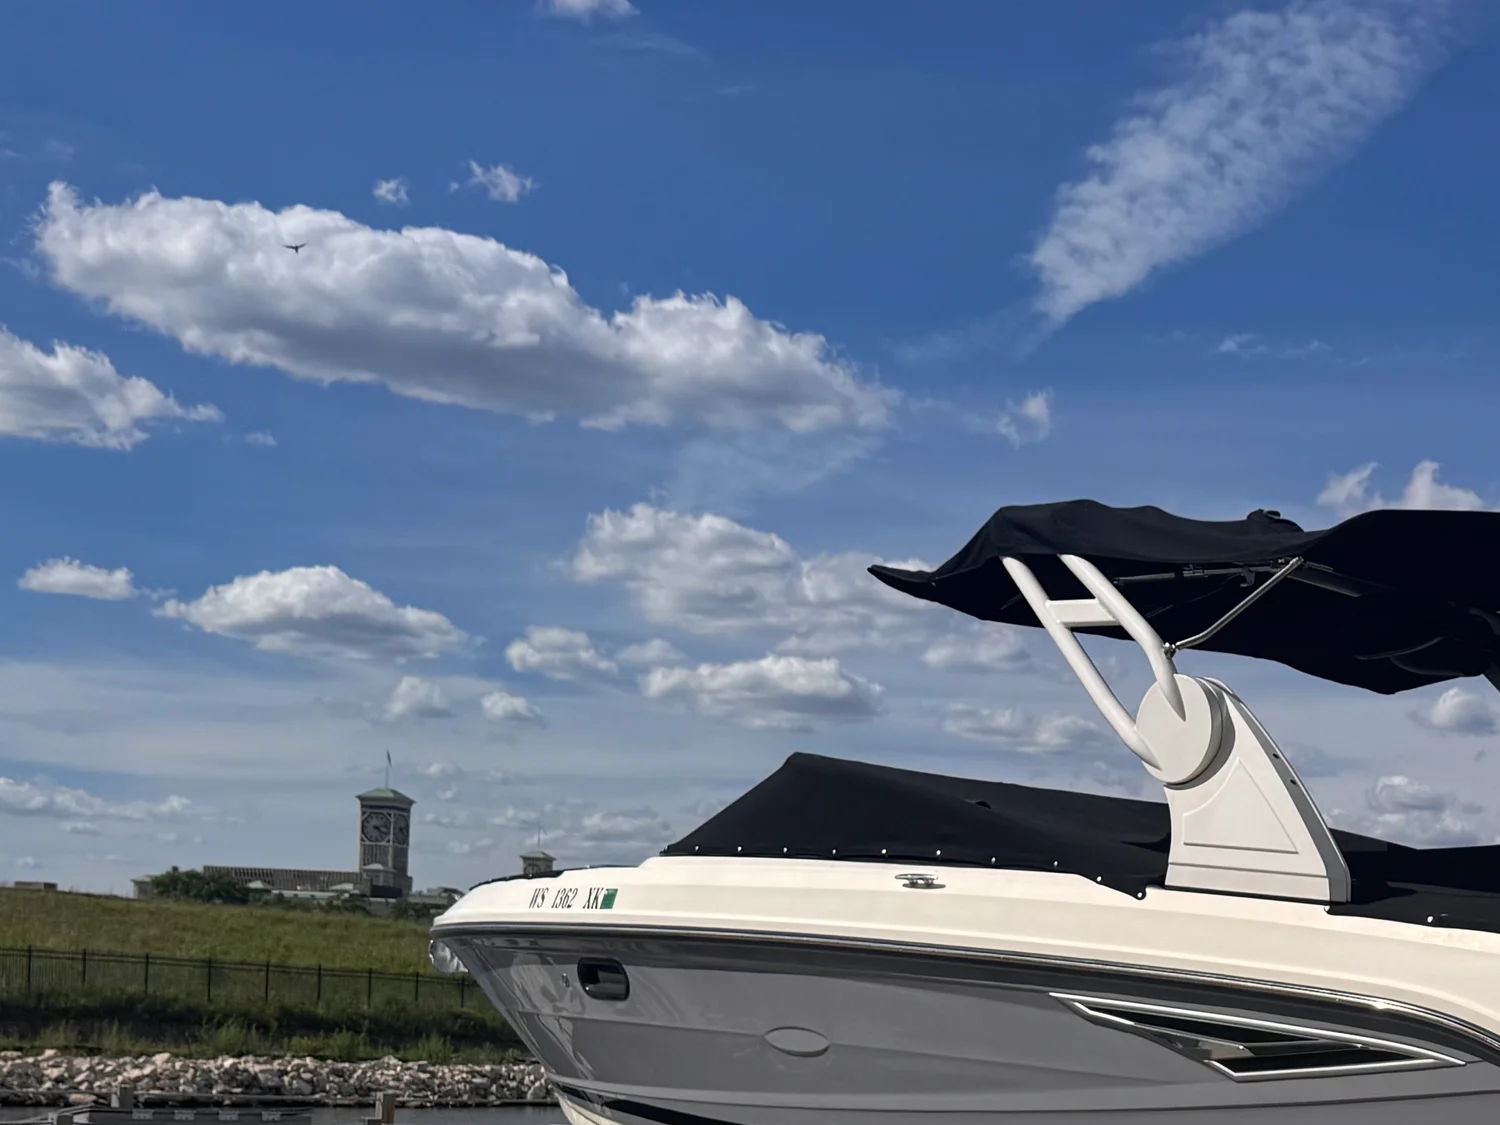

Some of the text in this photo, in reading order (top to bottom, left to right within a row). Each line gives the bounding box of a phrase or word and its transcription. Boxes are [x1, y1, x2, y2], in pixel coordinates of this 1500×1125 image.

[528, 887, 604, 909] WS 1362 XK
